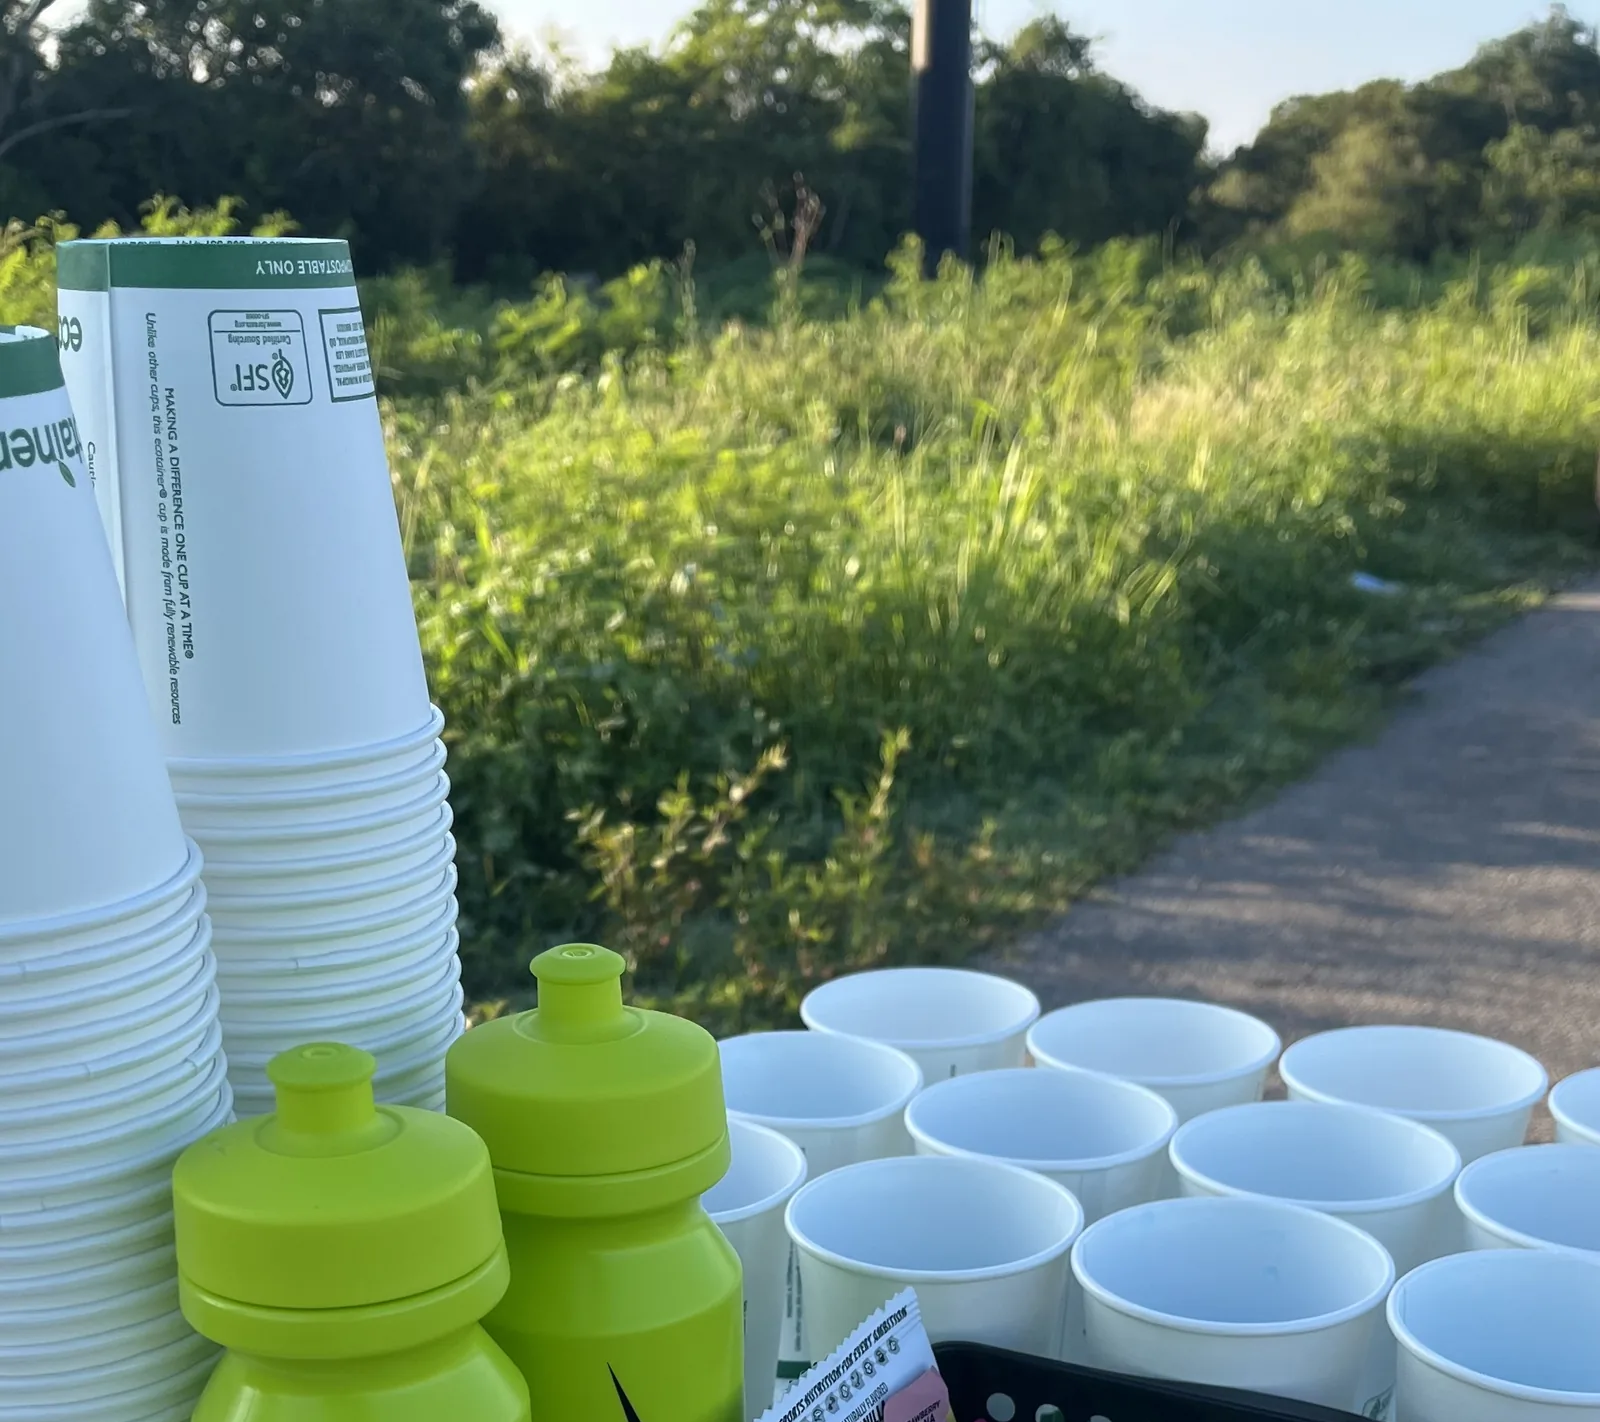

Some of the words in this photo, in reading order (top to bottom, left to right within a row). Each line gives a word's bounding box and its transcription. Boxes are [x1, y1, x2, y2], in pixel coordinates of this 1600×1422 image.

[256, 260, 293, 275] ONLY
[145, 312, 157, 348] Unlike
[228, 333, 261, 347] Sourcing
[262, 334, 291, 346] Certified
[148, 350, 158, 382] other
[150, 383, 161, 412] cups,
[153, 415, 161, 435] this
[165, 388, 178, 441] MAKING
[168, 442, 179, 454] A
[170, 456, 185, 531] DIFFERENCE
[158, 502, 168, 522] cup
[161, 536, 173, 569] made
[175, 533, 187, 561] ONE
[161, 570, 176, 596] from
[177, 563, 190, 590] CUP
[163, 598, 177, 621] fully
[179, 591, 191, 609] AT
[181, 612, 191, 621] A
[166, 622, 182, 675] renewable
[170, 676, 182, 725] resources
[804, 1363, 843, 1408] NUTRITION
[841, 1350, 854, 1374] FOR
[852, 1333, 873, 1359] EVERY
[872, 1304, 908, 1344] AMBITION
[865, 1381, 889, 1410] FLAVORED
